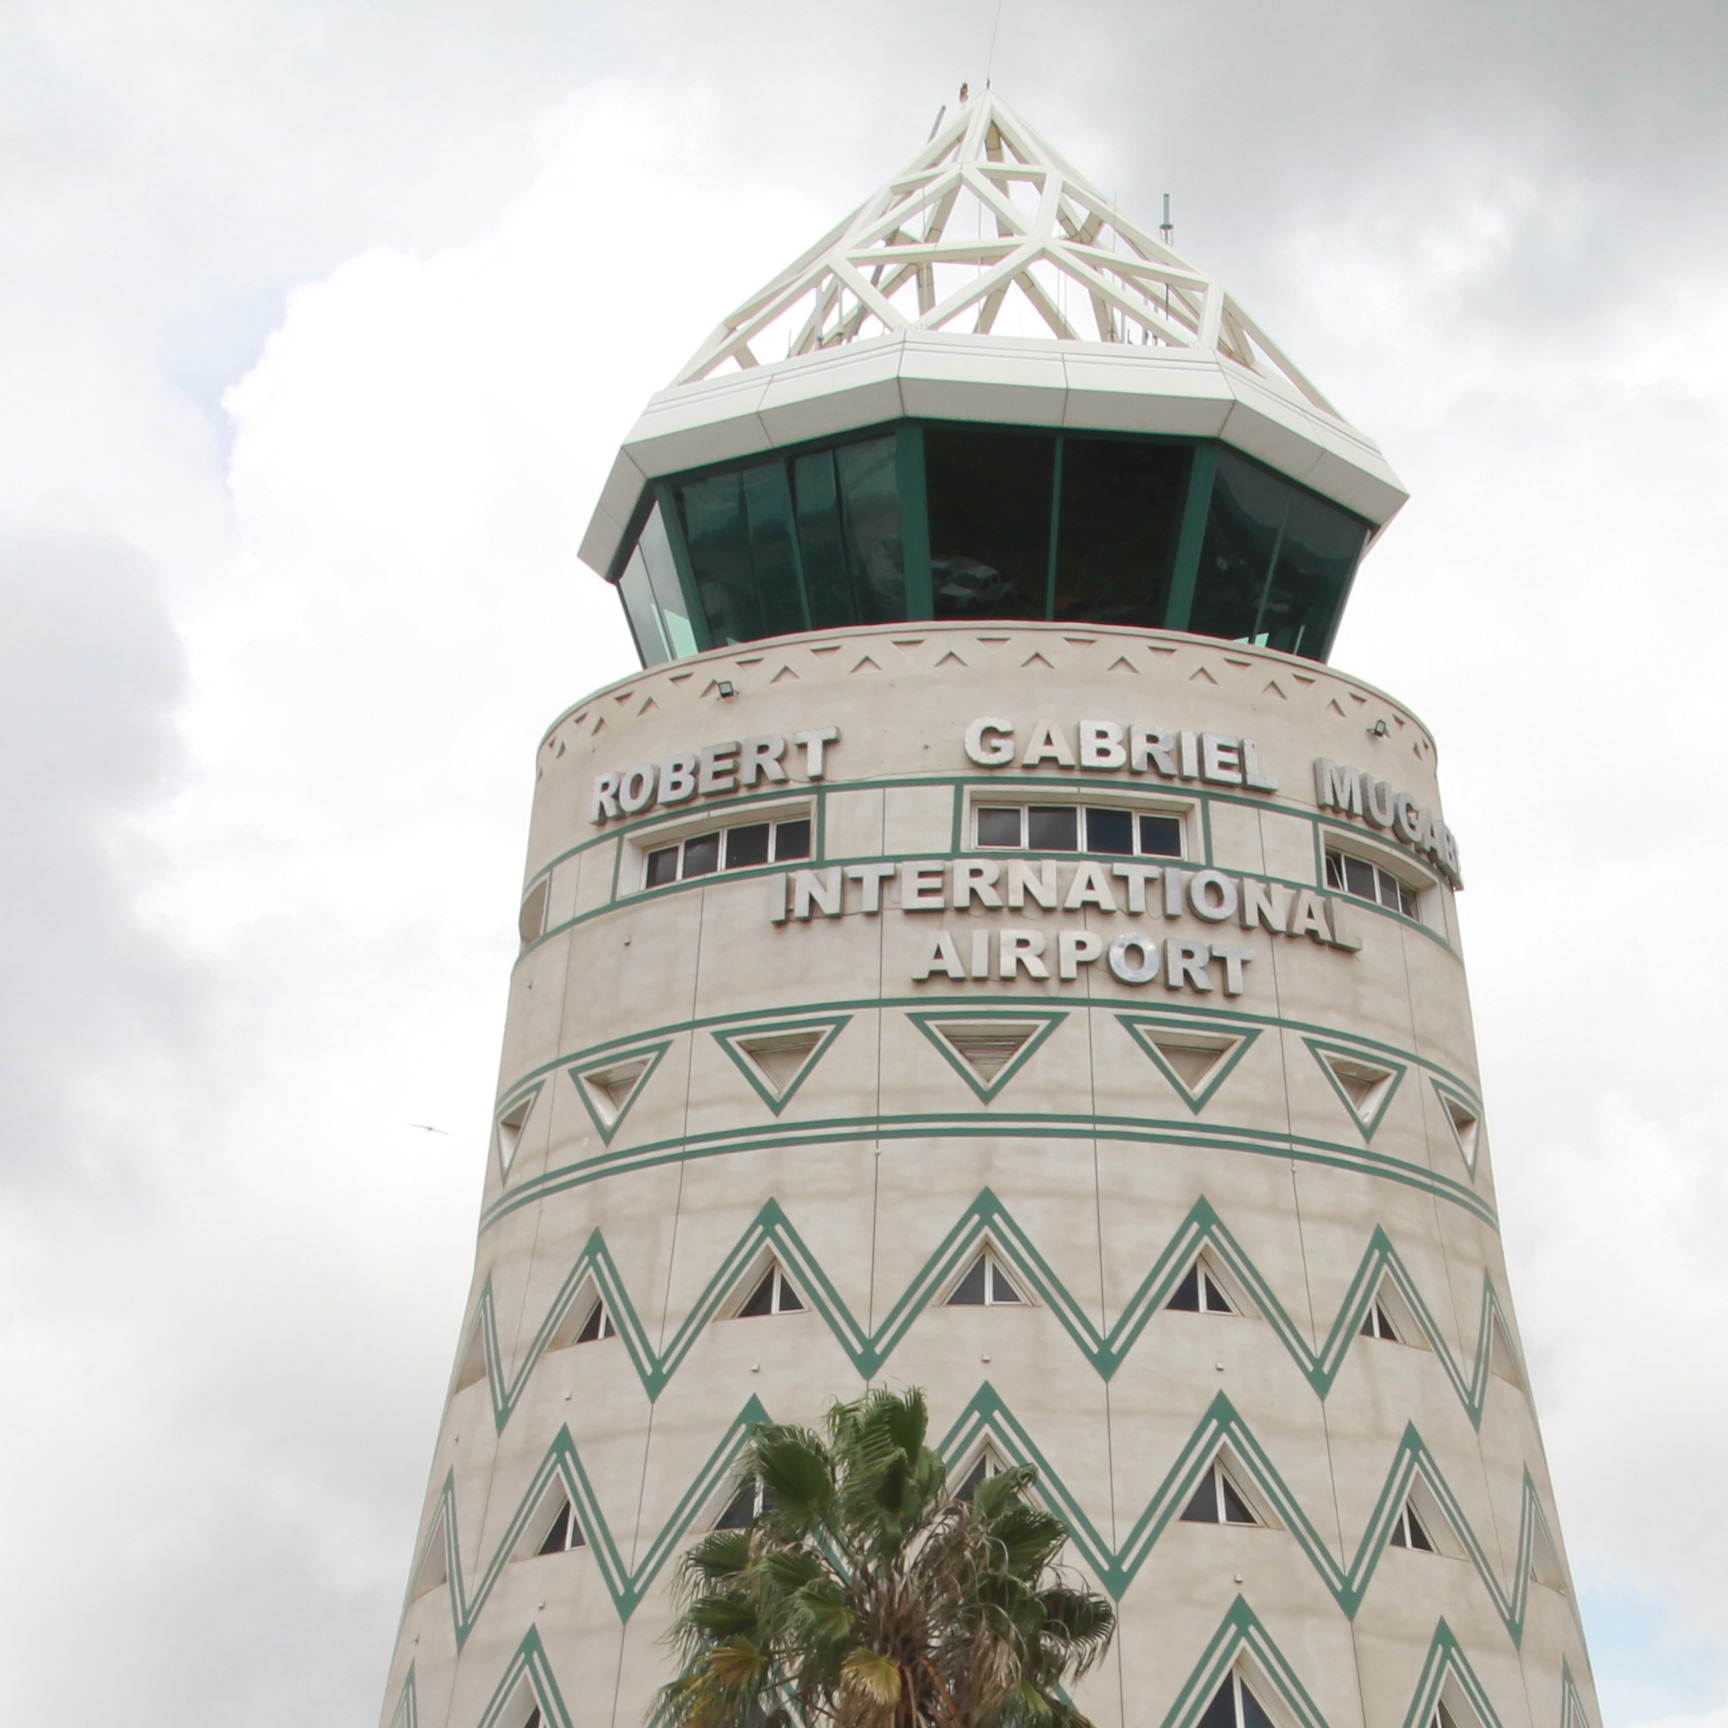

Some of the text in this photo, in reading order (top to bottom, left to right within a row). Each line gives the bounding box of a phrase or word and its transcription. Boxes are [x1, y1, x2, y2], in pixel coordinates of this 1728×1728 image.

[589, 716, 1464, 891] ROBERT GABRIEL MUGAB
[771, 859, 1362, 952] INTERNATIONAL
[911, 929, 1254, 997] AIRPORT
